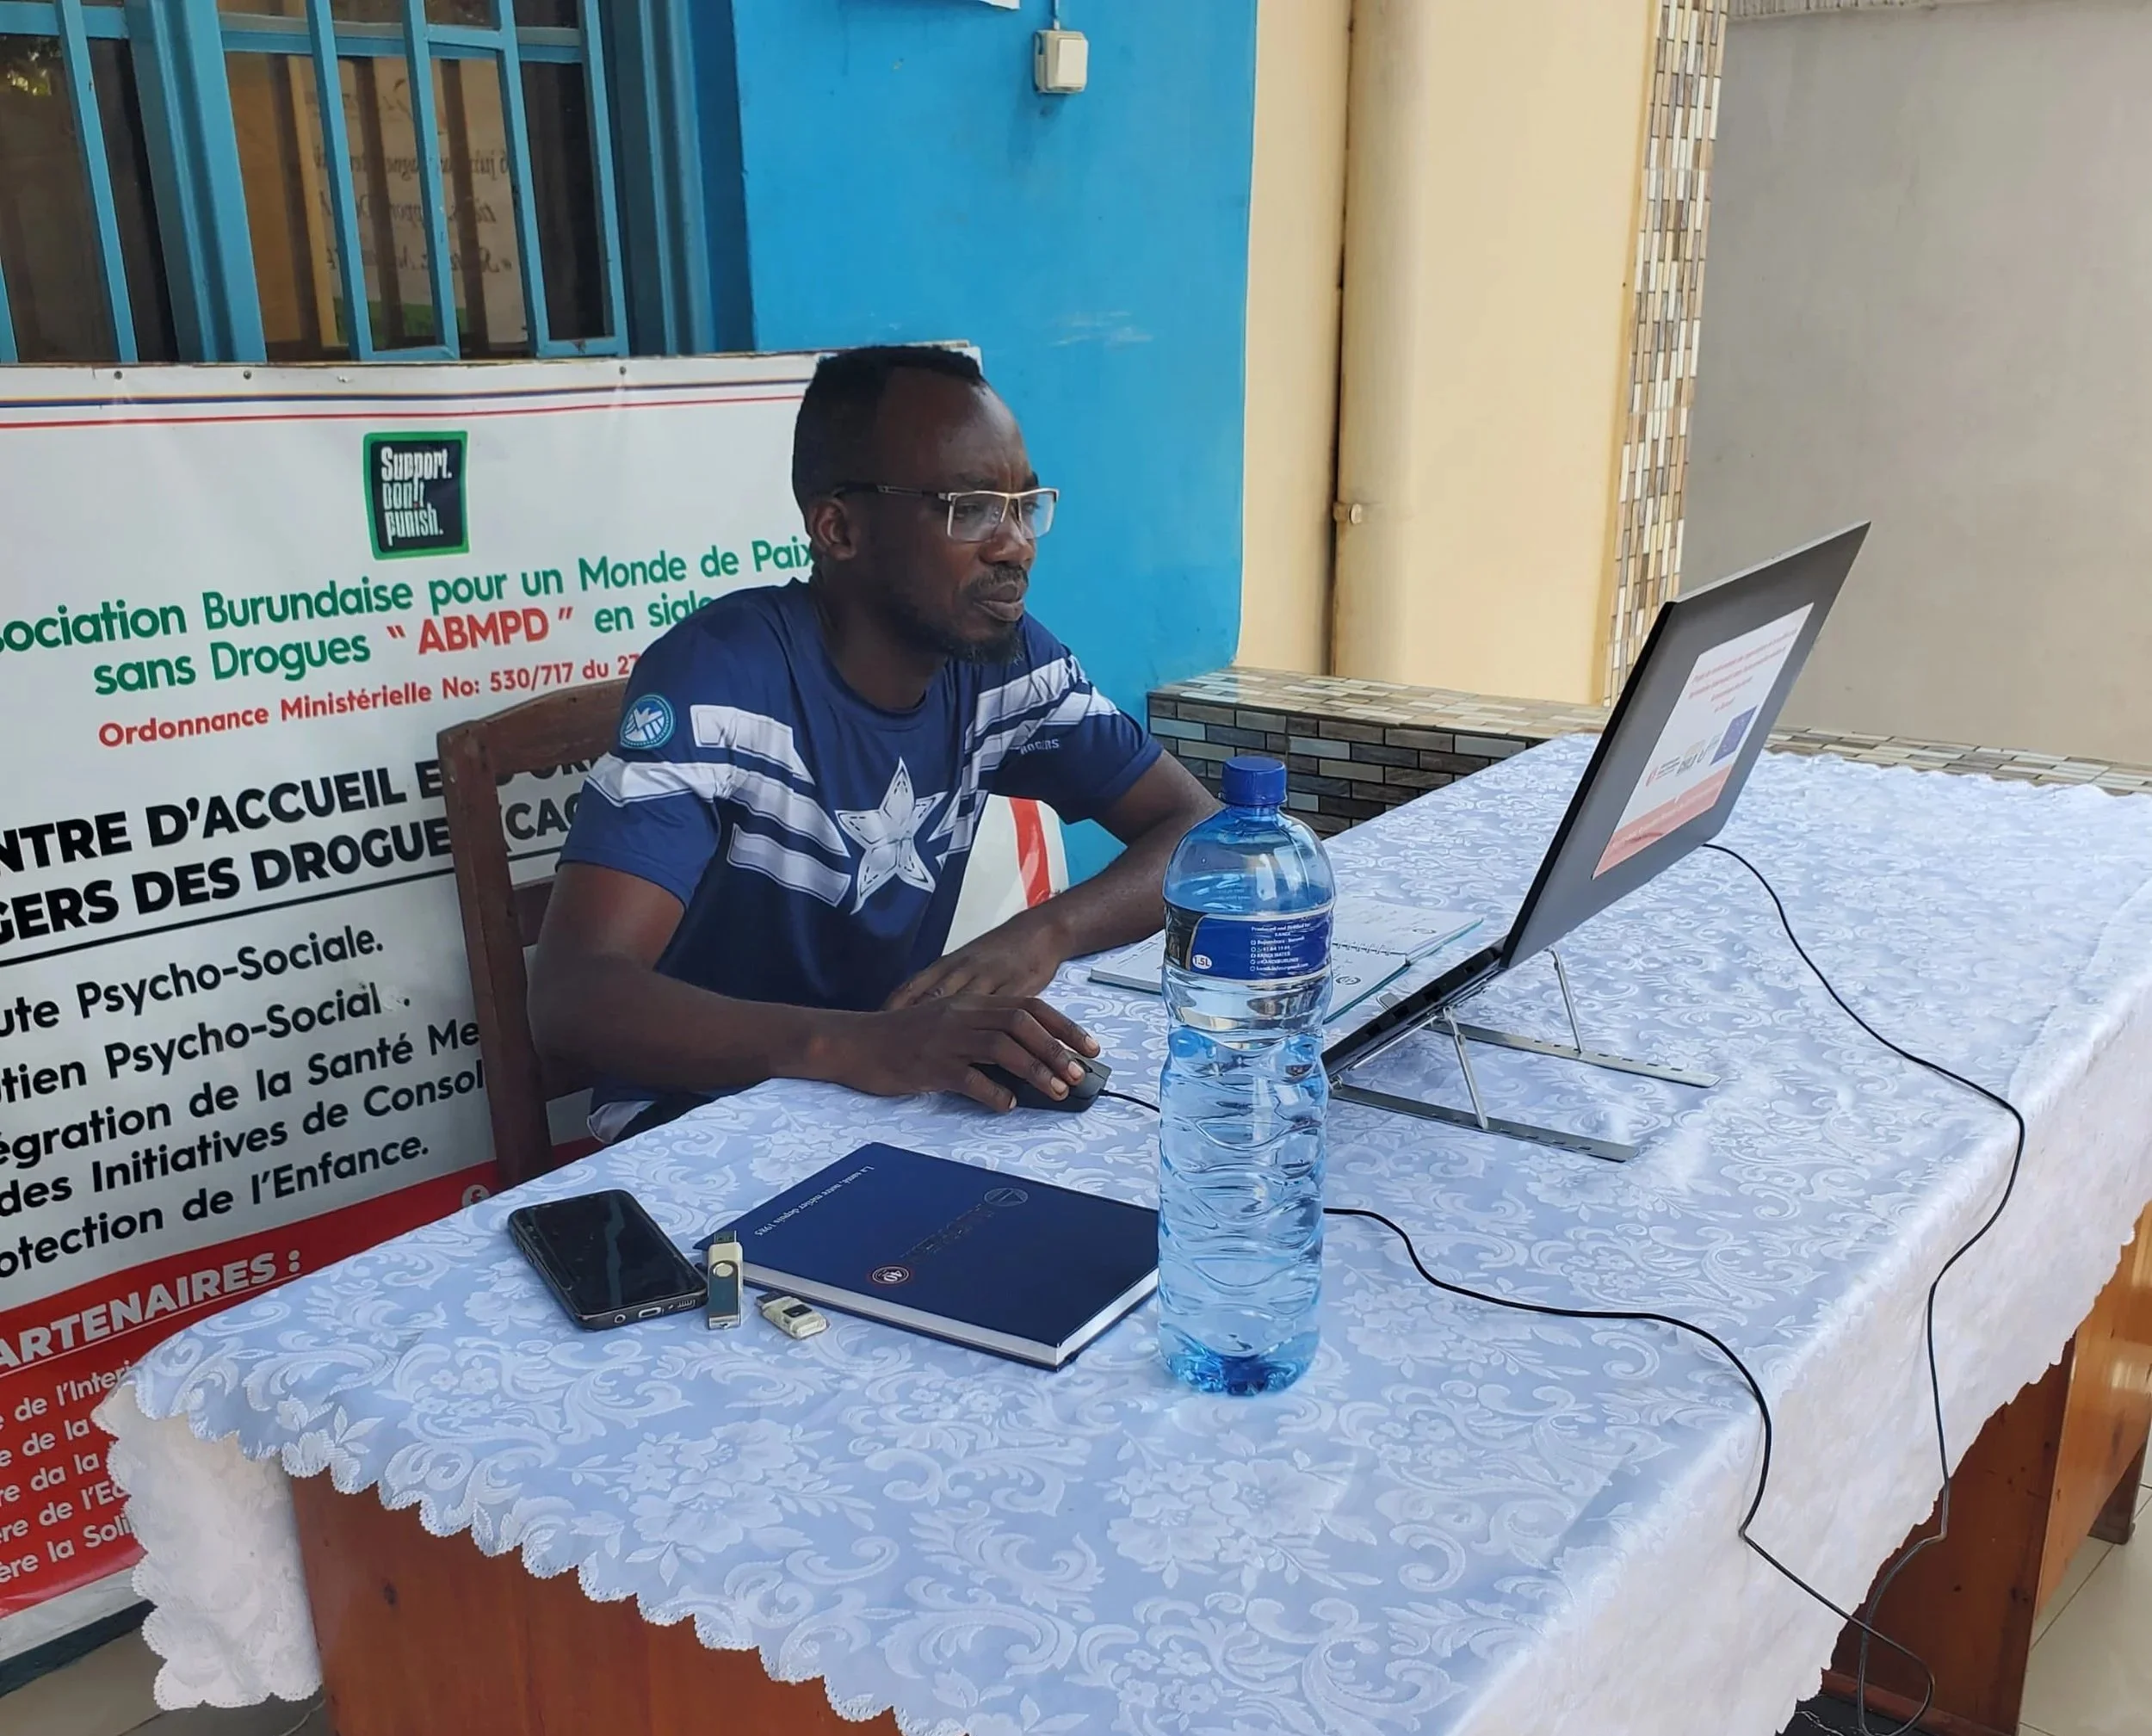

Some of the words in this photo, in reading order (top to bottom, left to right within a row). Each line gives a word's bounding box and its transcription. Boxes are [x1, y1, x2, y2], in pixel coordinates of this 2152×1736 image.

[380, 446, 453, 482] Support.
[385, 502, 444, 547] punish.
[0, 600, 187, 652] ociation
[201, 576, 413, 629] Burundaise
[430, 572, 508, 618] pour
[522, 568, 564, 596] un
[578, 550, 687, 591] Monde
[701, 545, 739, 578] de
[94, 652, 195, 695] sans
[211, 632, 370, 682] Drogues
[594, 606, 634, 633] en
[99, 705, 269, 747] Ordonnance
[281, 683, 432, 721] Ministérielle
[442, 676, 479, 699] No:
[490, 663, 573, 690] 530/717
[583, 659, 609, 680] du
[145, 767, 407, 848] D'ACCUEIL
[132, 858, 240, 915] DES
[251, 818, 452, 893] DROGUE
[77, 925, 384, 1018] Psycho-Sociale.
[189, 1083, 239, 1118] de
[257, 1070, 291, 1101] la
[307, 1033, 414, 1086] Santé
[428, 1018, 479, 1056] Me
[0, 1179, 72, 1217] des
[92, 1119, 288, 1193] Initiatives
[302, 1102, 349, 1135] de
[363, 1060, 484, 1118] Consol
[182, 1189, 233, 1223] de
[251, 1135, 429, 1205] l'Enfance.
[15, 1398, 47, 1421] de
[22, 1432, 56, 1456] de
[64, 1419, 90, 1441] la
[30, 1467, 66, 1491] da
[73, 1453, 100, 1475] la
[39, 1502, 73, 1526] de
[46, 1540, 74, 1563] la
